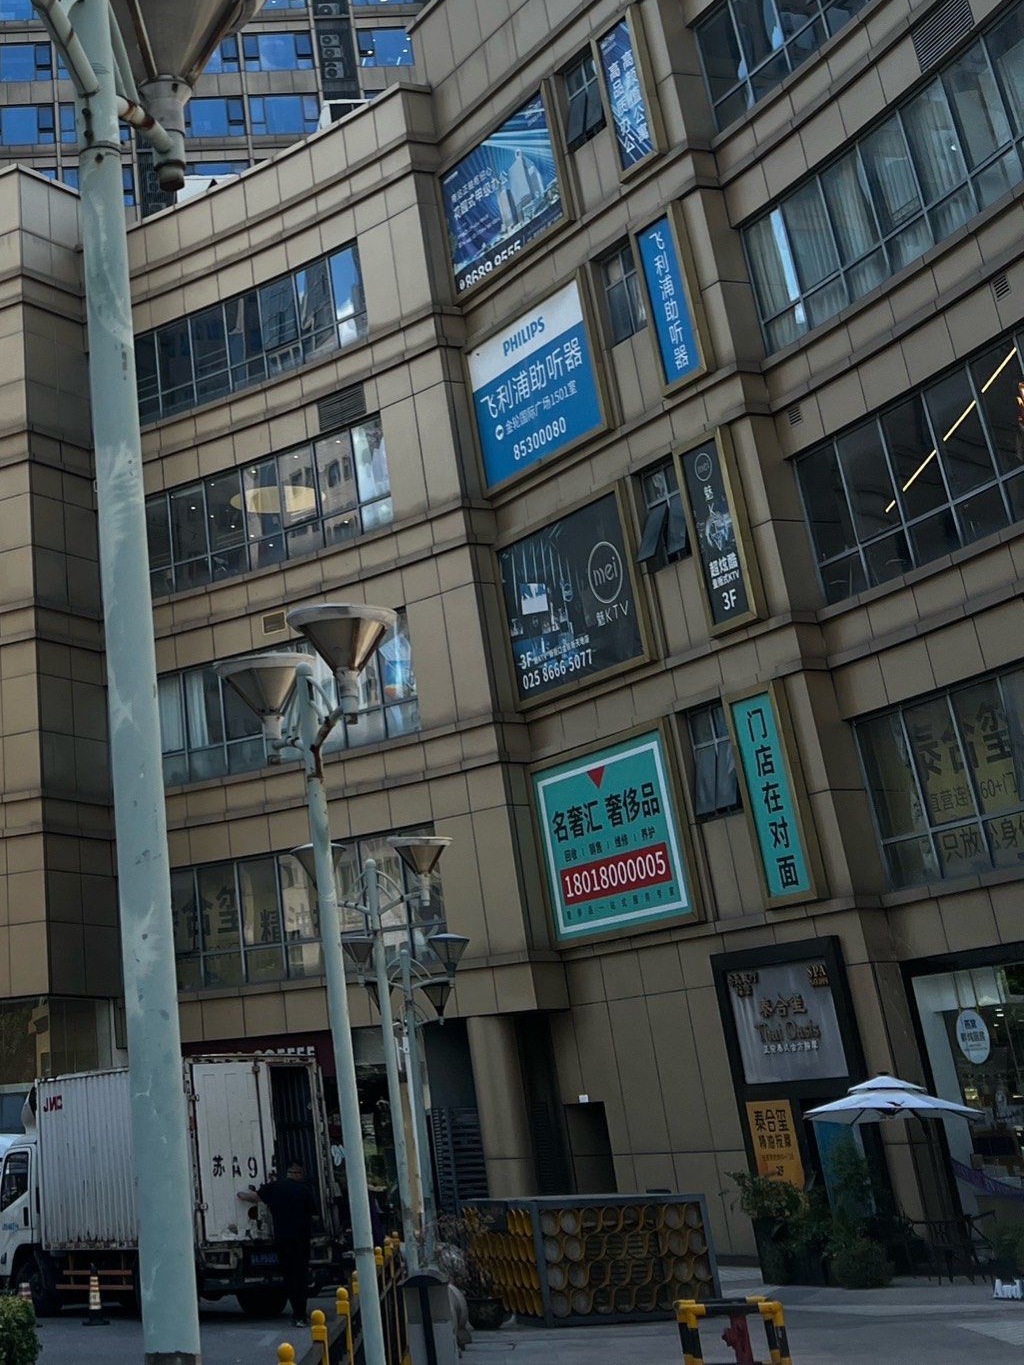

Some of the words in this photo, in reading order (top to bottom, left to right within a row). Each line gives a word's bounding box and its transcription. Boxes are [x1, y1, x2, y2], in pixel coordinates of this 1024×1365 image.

[649, 231, 689, 370] 飞利浦助听器
[502, 316, 545, 356] PHILIPS
[480, 337, 583, 418] 飞利浦助听器
[513, 417, 567, 460] 85300080
[592, 556, 618, 586] mei
[721, 588, 737, 611] 3F
[519, 651, 532, 670] 3F
[523, 672, 541, 689] 025
[542, 659, 567, 682] 8666
[568, 649, 593, 671] 5077
[552, 800, 603, 843] 名奢汇
[604, 782, 660, 828] 奢侈品
[747, 707, 800, 889] 门店在对面
[565, 851, 666, 898] 18018000005
